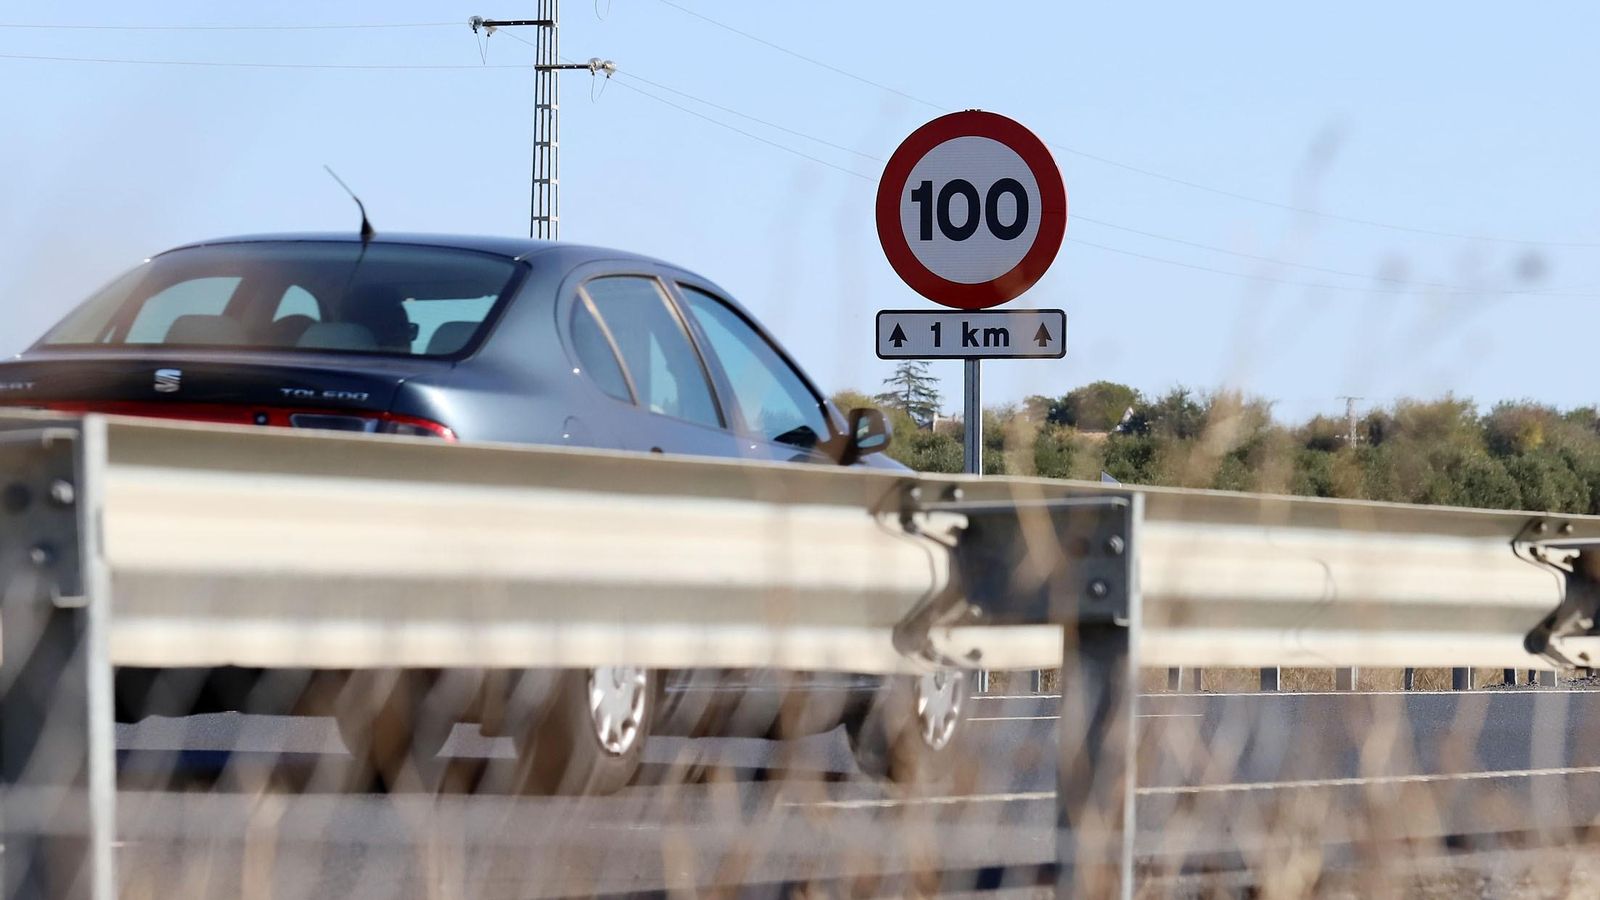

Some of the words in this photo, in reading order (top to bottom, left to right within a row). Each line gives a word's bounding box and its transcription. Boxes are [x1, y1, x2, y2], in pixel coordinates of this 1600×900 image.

[911, 178, 1029, 241] 100
[931, 322, 941, 347] 1
[962, 322, 1010, 347] km
[280, 387, 369, 401] TOLEDO
